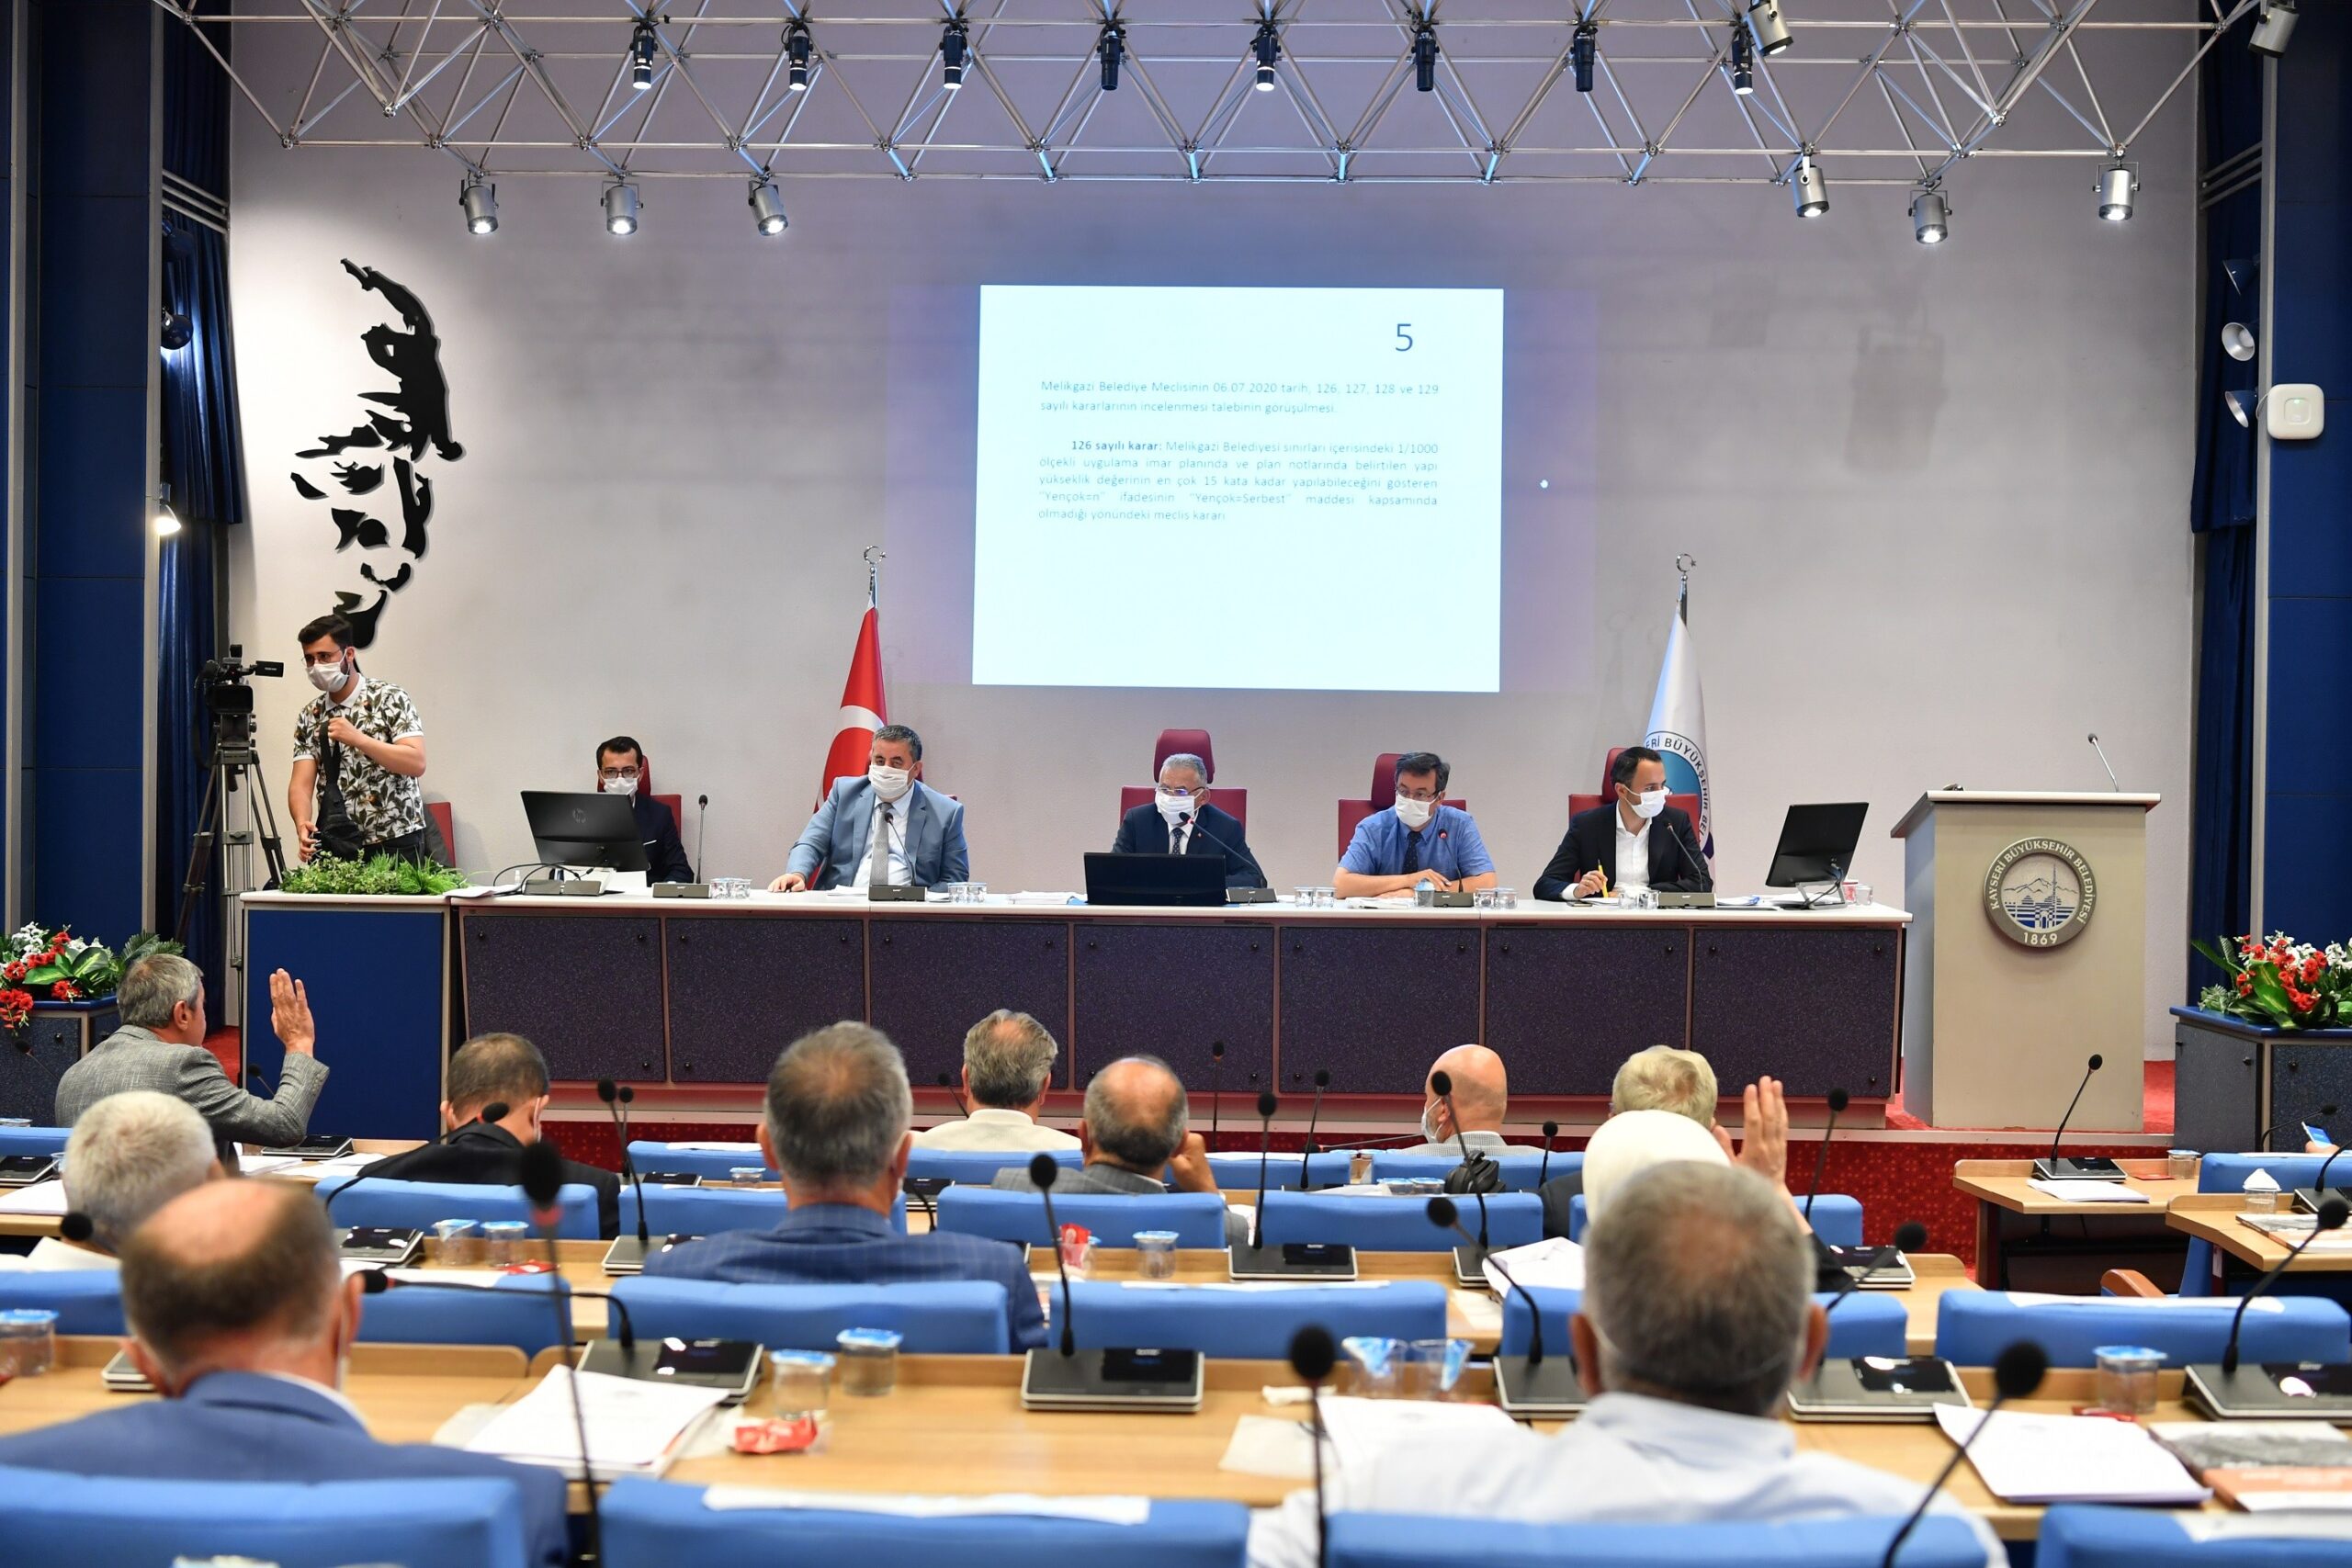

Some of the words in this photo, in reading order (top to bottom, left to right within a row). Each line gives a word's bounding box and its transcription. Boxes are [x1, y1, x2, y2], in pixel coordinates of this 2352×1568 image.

[1395, 323, 1413, 352] 5
[1040, 381, 1094, 393] Melikgazi
[1099, 381, 1148, 392] Belediye
[1374, 384, 1396, 394] 128
[1399, 386, 1415, 395] ve
[1418, 384, 1440, 396] 129
[1040, 400, 1069, 412] sayılı
[1211, 402, 1261, 412] talebinin
[1071, 440, 1092, 451] 126
[1095, 440, 1125, 453] sayılı
[1165, 441, 1219, 454] Melikgazi
[1223, 441, 1281, 454] Belediyesi
[1398, 444, 1440, 455] 1/1000
[1083, 457, 1138, 470] uygulama
[1179, 458, 1228, 469] planında
[1256, 459, 1282, 471] plan
[1288, 461, 1348, 469] notlarında
[1414, 462, 1439, 473] yapı
[1096, 475, 1151, 487] değerinin
[1156, 477, 1171, 485] en
[1177, 476, 1197, 488] çok
[1204, 476, 1217, 486] 15
[1224, 477, 1249, 486] kata
[1254, 477, 1285, 487] kadar
[1119, 492, 1175, 502] ifadesinin
[1368, 496, 1438, 507] kapsamında
[1154, 510, 1191, 521] meclis
[1989, 860, 2007, 910] KAYSERİ
[2004, 840, 2076, 863] BÜYÜKŞEHİR
[2074, 859, 2096, 925] BELEDİYESİ
[2023, 932, 2058, 945] 1869
